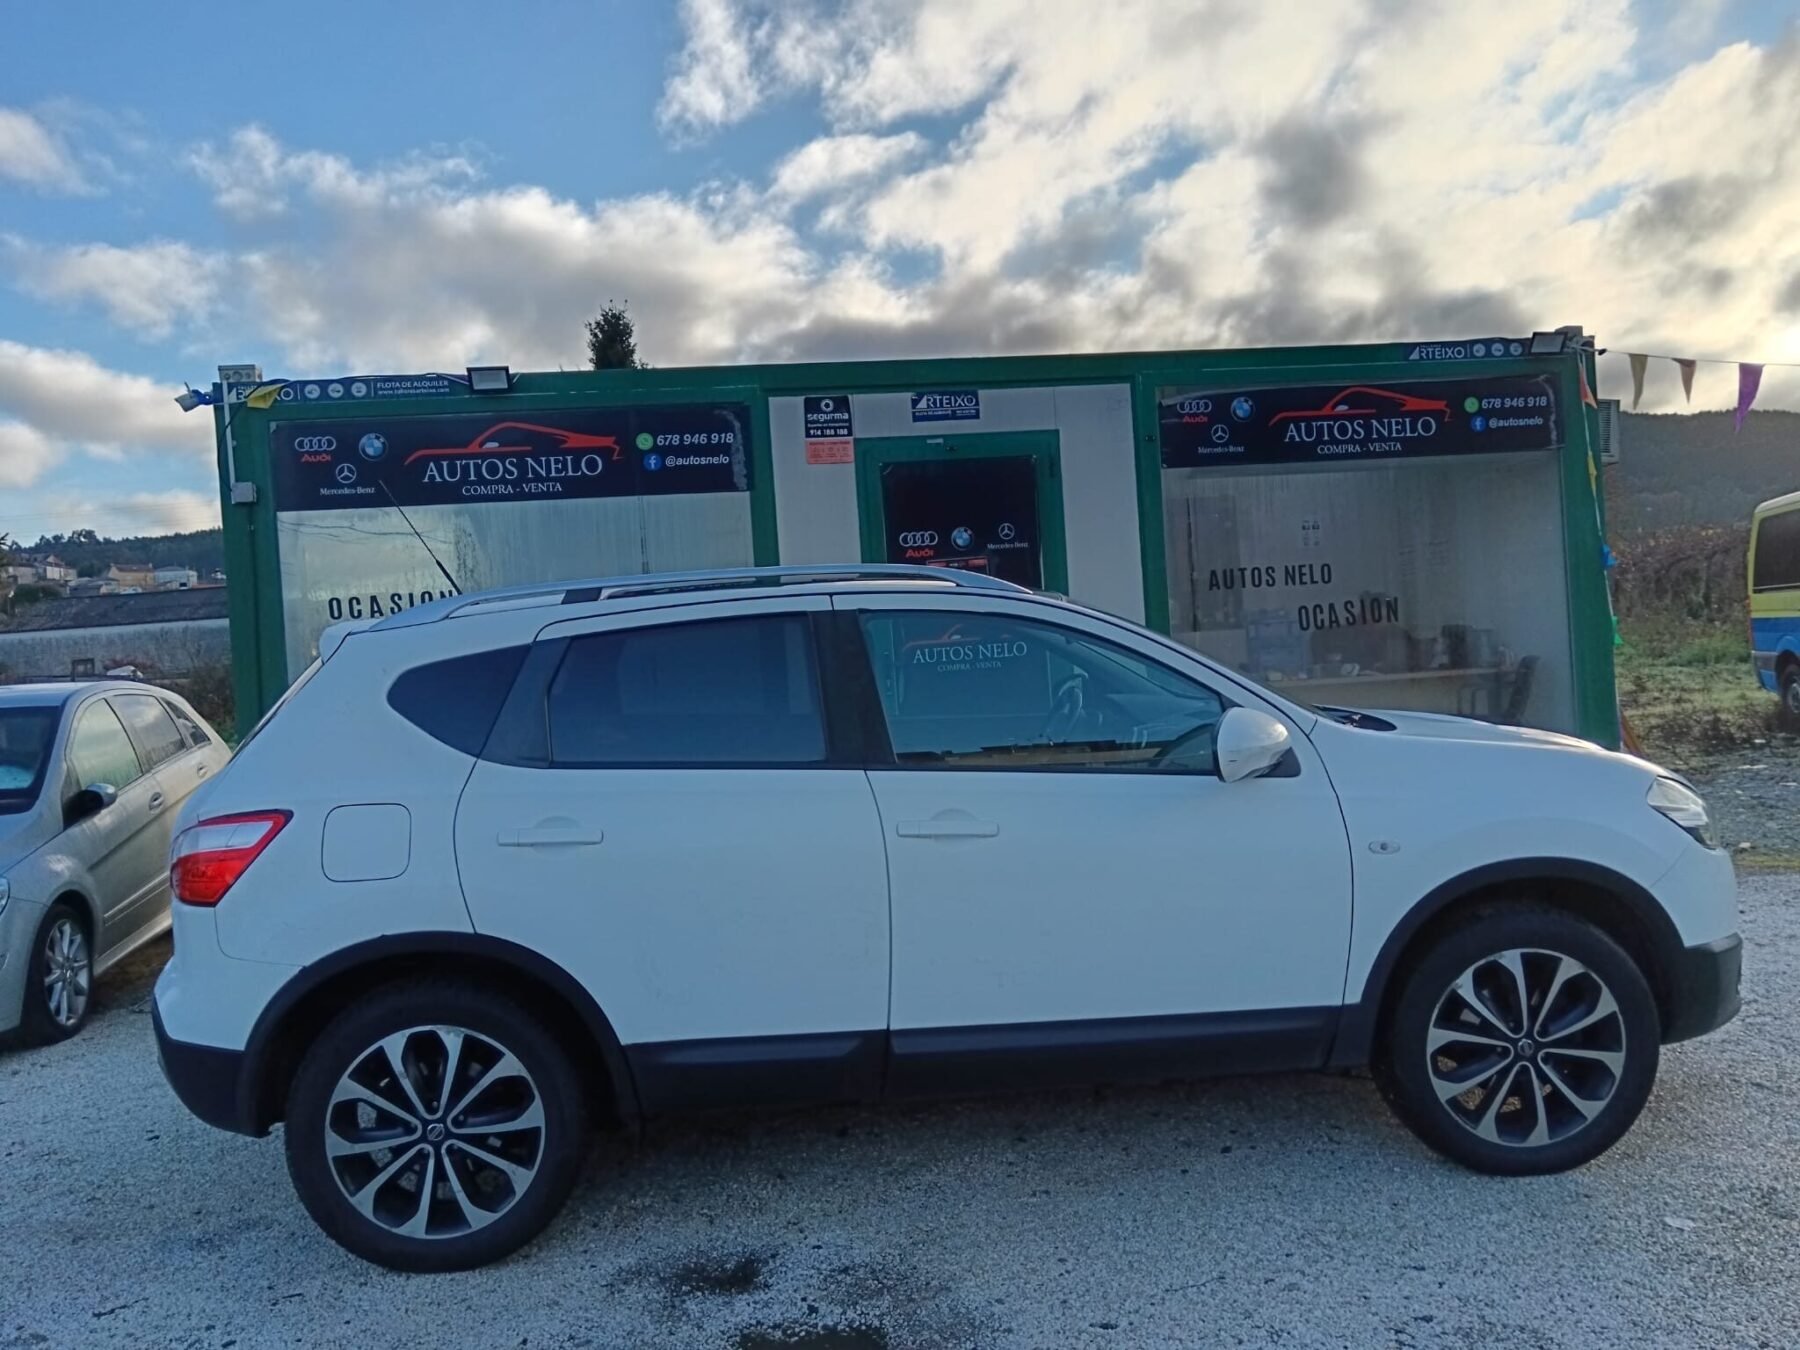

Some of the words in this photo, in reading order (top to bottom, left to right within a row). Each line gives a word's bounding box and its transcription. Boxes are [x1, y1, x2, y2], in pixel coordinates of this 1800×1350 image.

[413, 380, 449, 388] ALQUILER
[1481, 398, 1501, 409] 678
[1503, 397, 1525, 408] 946
[1527, 396, 1548, 407] 918
[1283, 420, 1365, 442] AUTOS
[1370, 416, 1436, 438] NELO
[1488, 415, 1544, 429] @autosnelo
[656, 434, 680, 446] 678
[683, 433, 708, 445] 946
[711, 432, 734, 444] 918
[1317, 444, 1361, 455] COMPRA
[1368, 442, 1402, 452] VENTA
[301, 453, 332, 462] Audi
[665, 454, 730, 467] @autosnelo
[422, 457, 518, 483] AUTOS
[524, 454, 603, 478] NELO
[462, 484, 514, 496] COMPRA
[522, 482, 563, 493] VENTA
[905, 548, 934, 558] Audi
[1208, 565, 1276, 591] AUTOS
[1284, 563, 1332, 586] NELO
[1297, 597, 1400, 631] OCASION
[913, 645, 974, 664] AUTOS
[978, 641, 1028, 659] NELO
